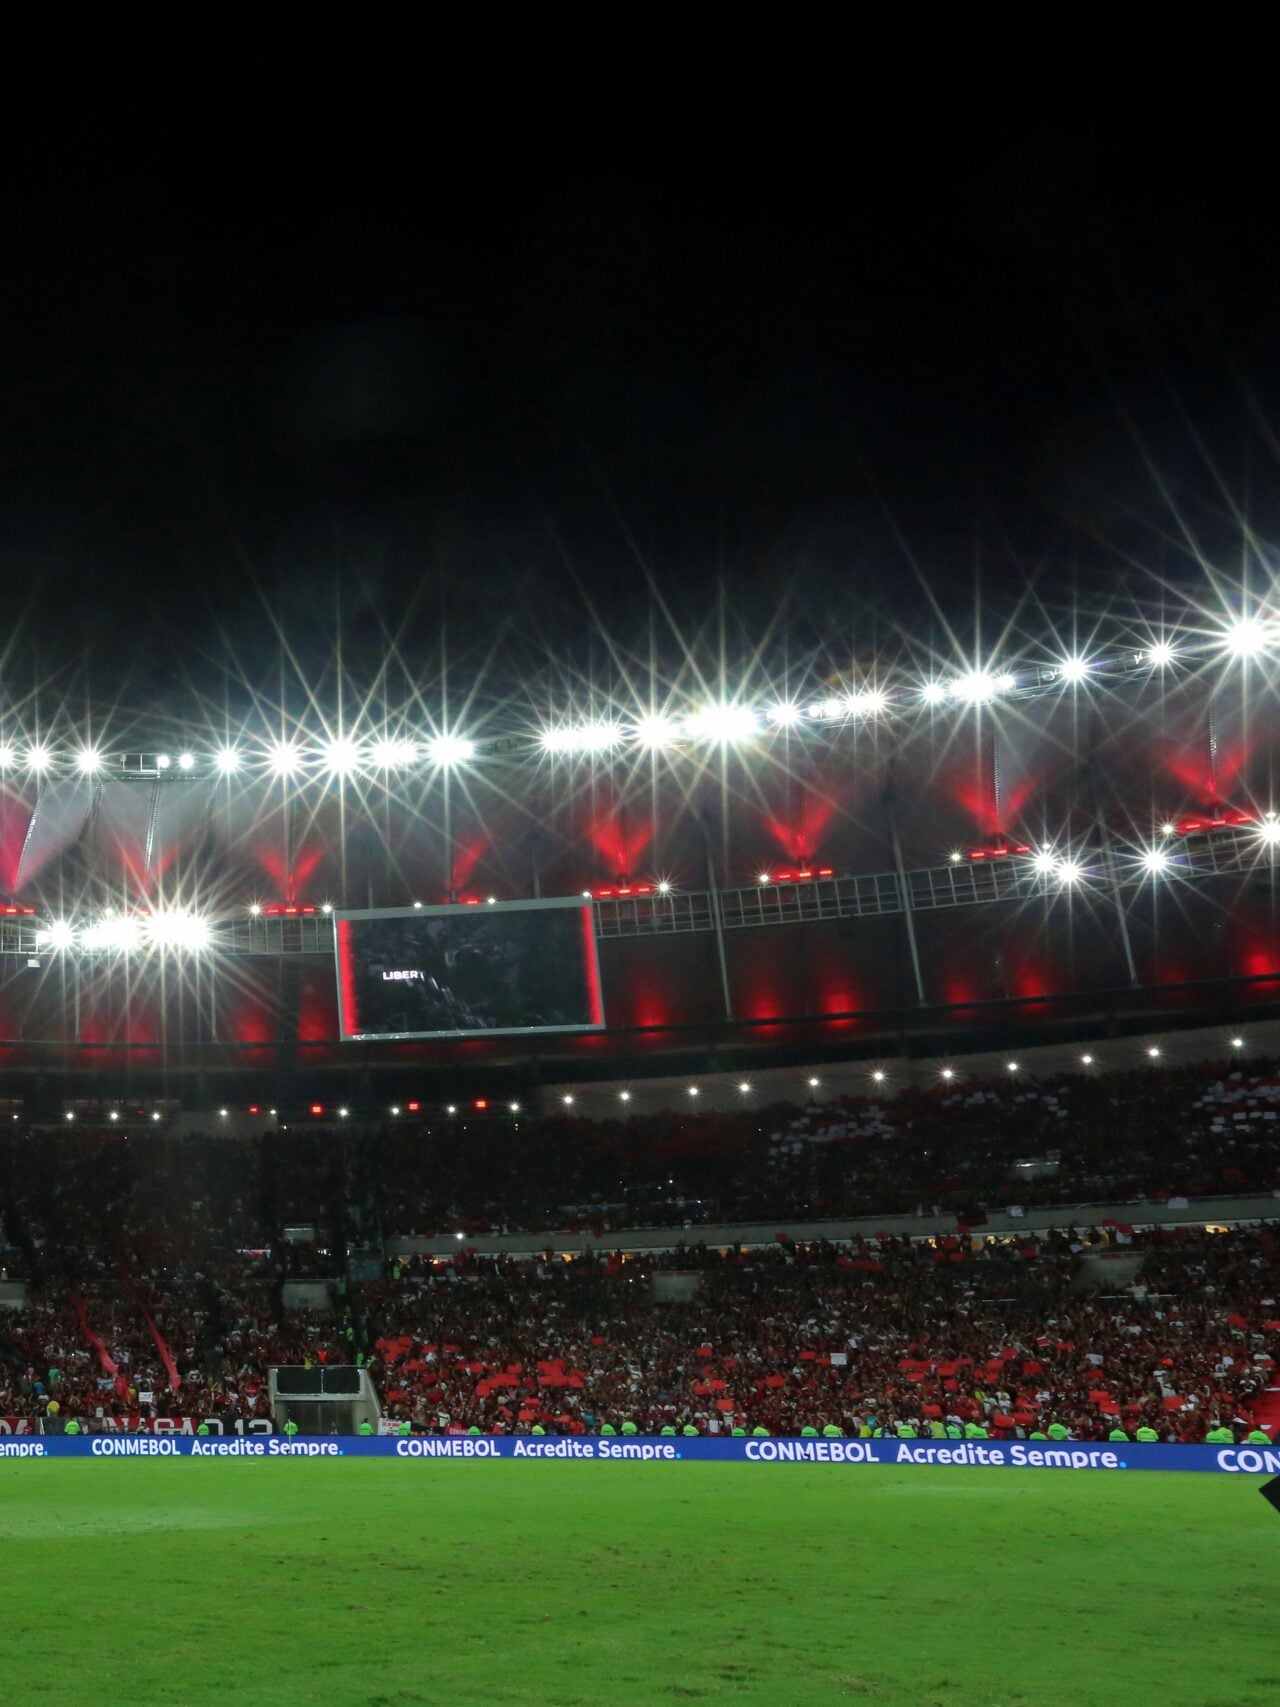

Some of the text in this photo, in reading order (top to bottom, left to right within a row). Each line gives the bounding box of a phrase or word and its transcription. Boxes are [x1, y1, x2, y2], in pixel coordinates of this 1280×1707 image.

[91, 1438, 344, 1457] CONMEBOL Acredite Sempre.
[396, 1438, 682, 1461] CONMEBOL Acredite Sempre.
[745, 1441, 1127, 1469] CONMEBOL Acredite Sempre.
